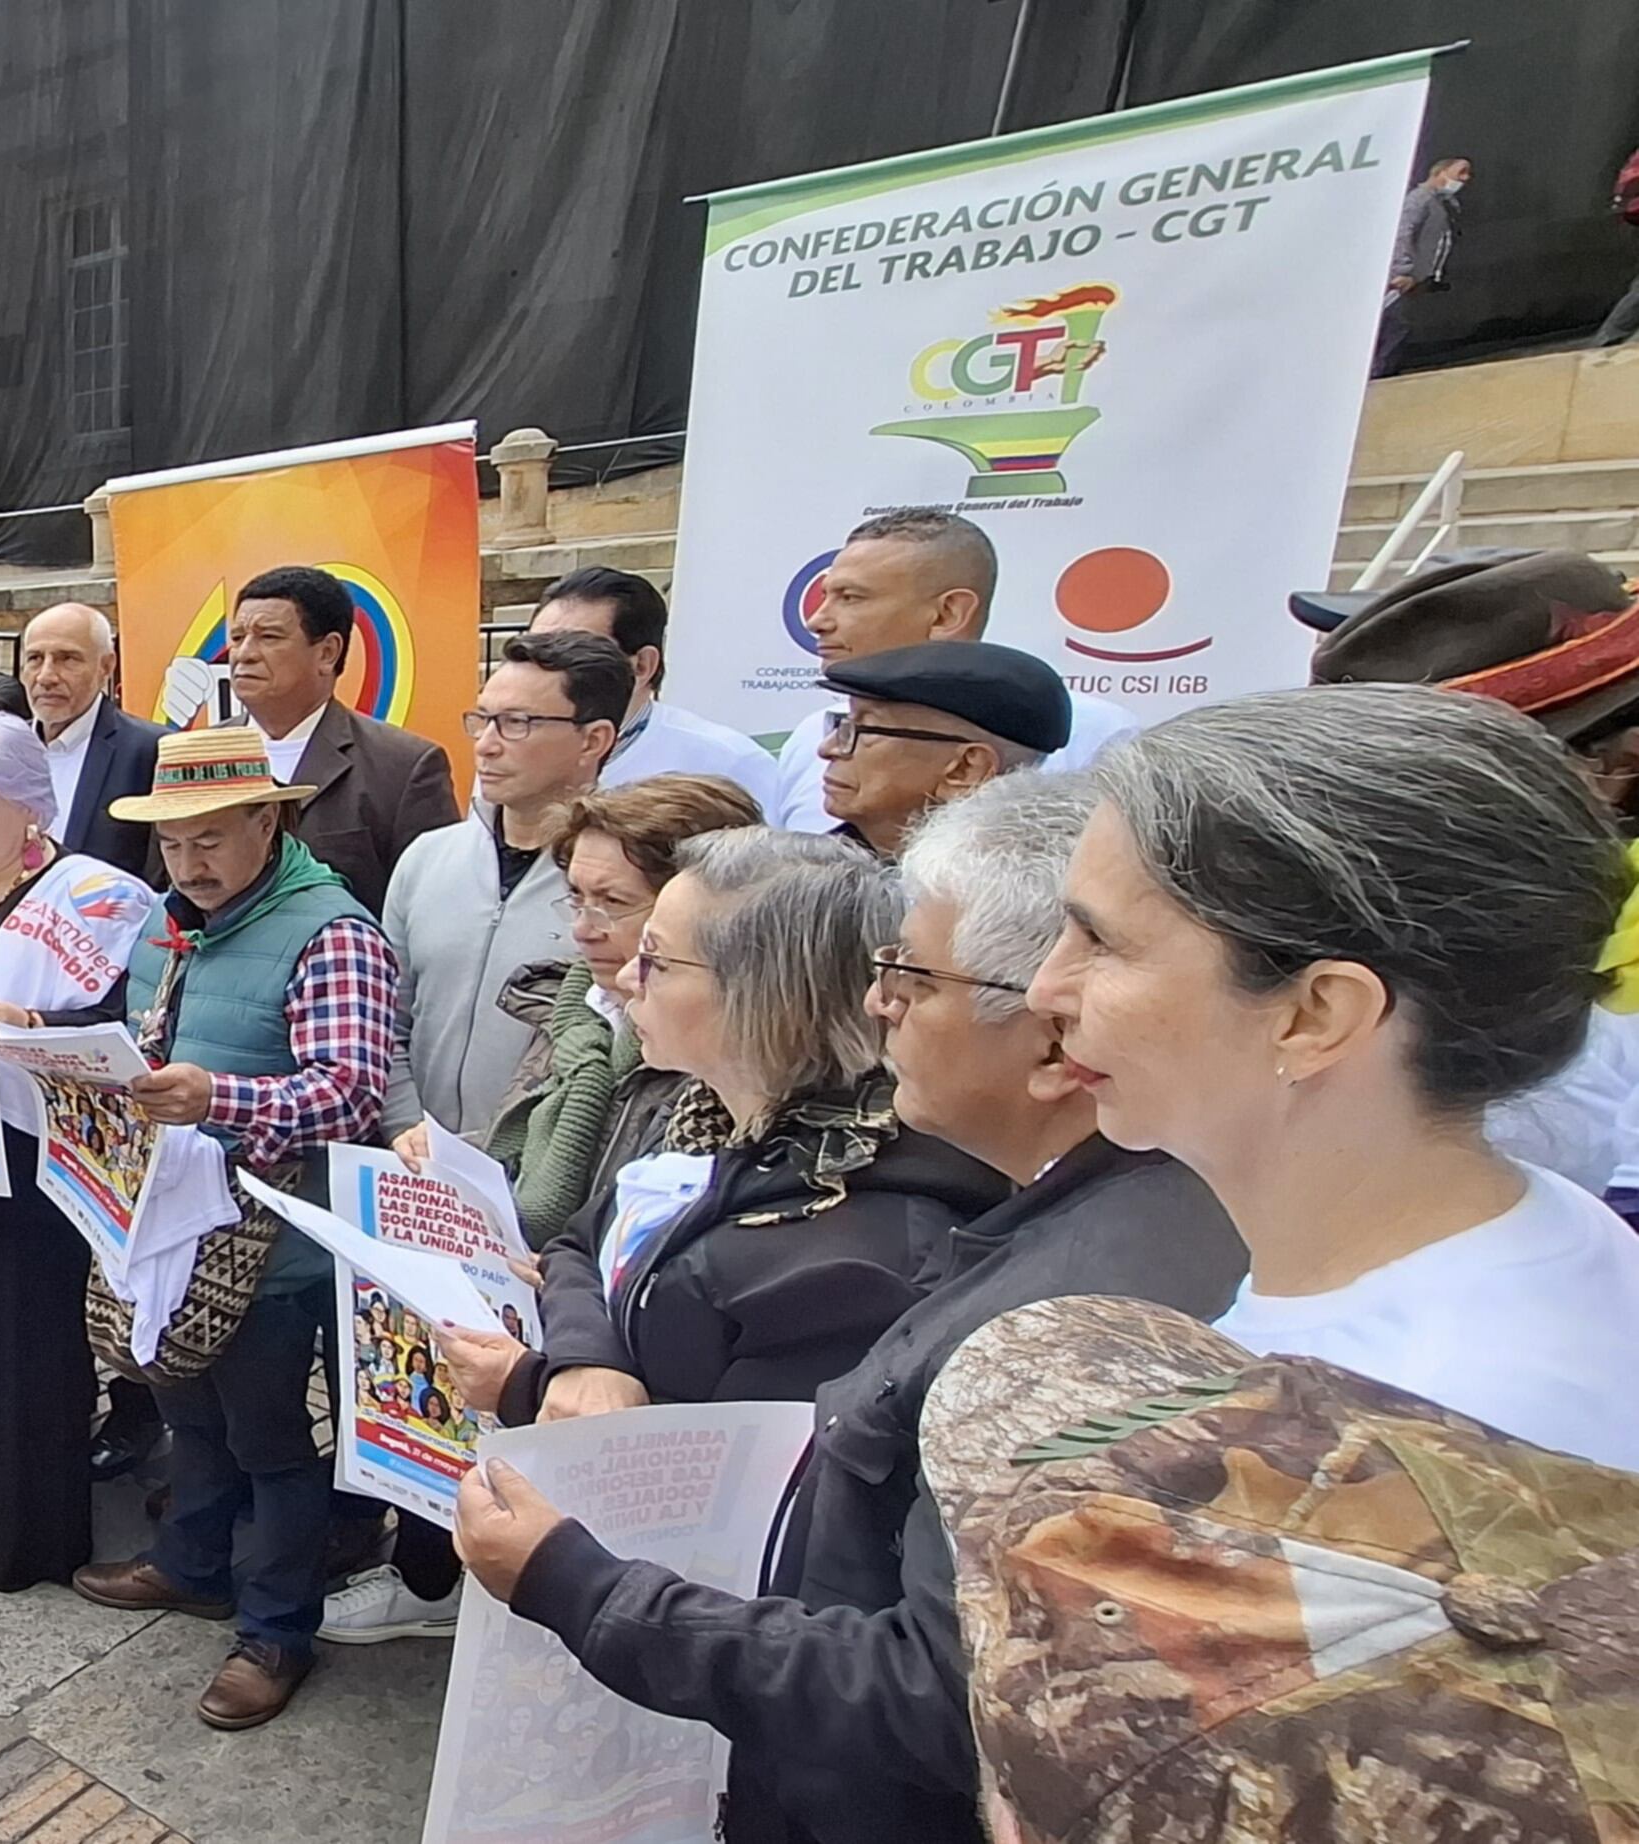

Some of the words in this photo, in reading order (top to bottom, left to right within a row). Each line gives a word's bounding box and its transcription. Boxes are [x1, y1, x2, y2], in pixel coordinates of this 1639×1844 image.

[724, 180, 1106, 272] CONFEDERACIÓN
[1118, 135, 1380, 206] GENERAL
[788, 262, 862, 298] DEL
[878, 224, 1102, 284] TRABAJO
[1151, 196, 1270, 243] CGT
[1008, 497, 1029, 508] del
[1031, 496, 1083, 508] Trabajo
[1062, 675, 1112, 694] TUC
[1121, 675, 1159, 694] CSI
[1168, 675, 1208, 694] IGB
[378, 1171, 459, 1198] ASAMBLEA
[378, 1185, 458, 1212] NACIONAL
[462, 1204, 484, 1223] POR
[379, 1198, 409, 1213] LAS
[415, 1205, 489, 1236] REFORMAS
[380, 1212, 459, 1241] SOCIALES,
[463, 1231, 480, 1247] LA
[484, 1240, 509, 1259] PAZ
[380, 1225, 389, 1237] Y
[394, 1227, 413, 1242] LA
[419, 1232, 474, 1258] UNIDAD
